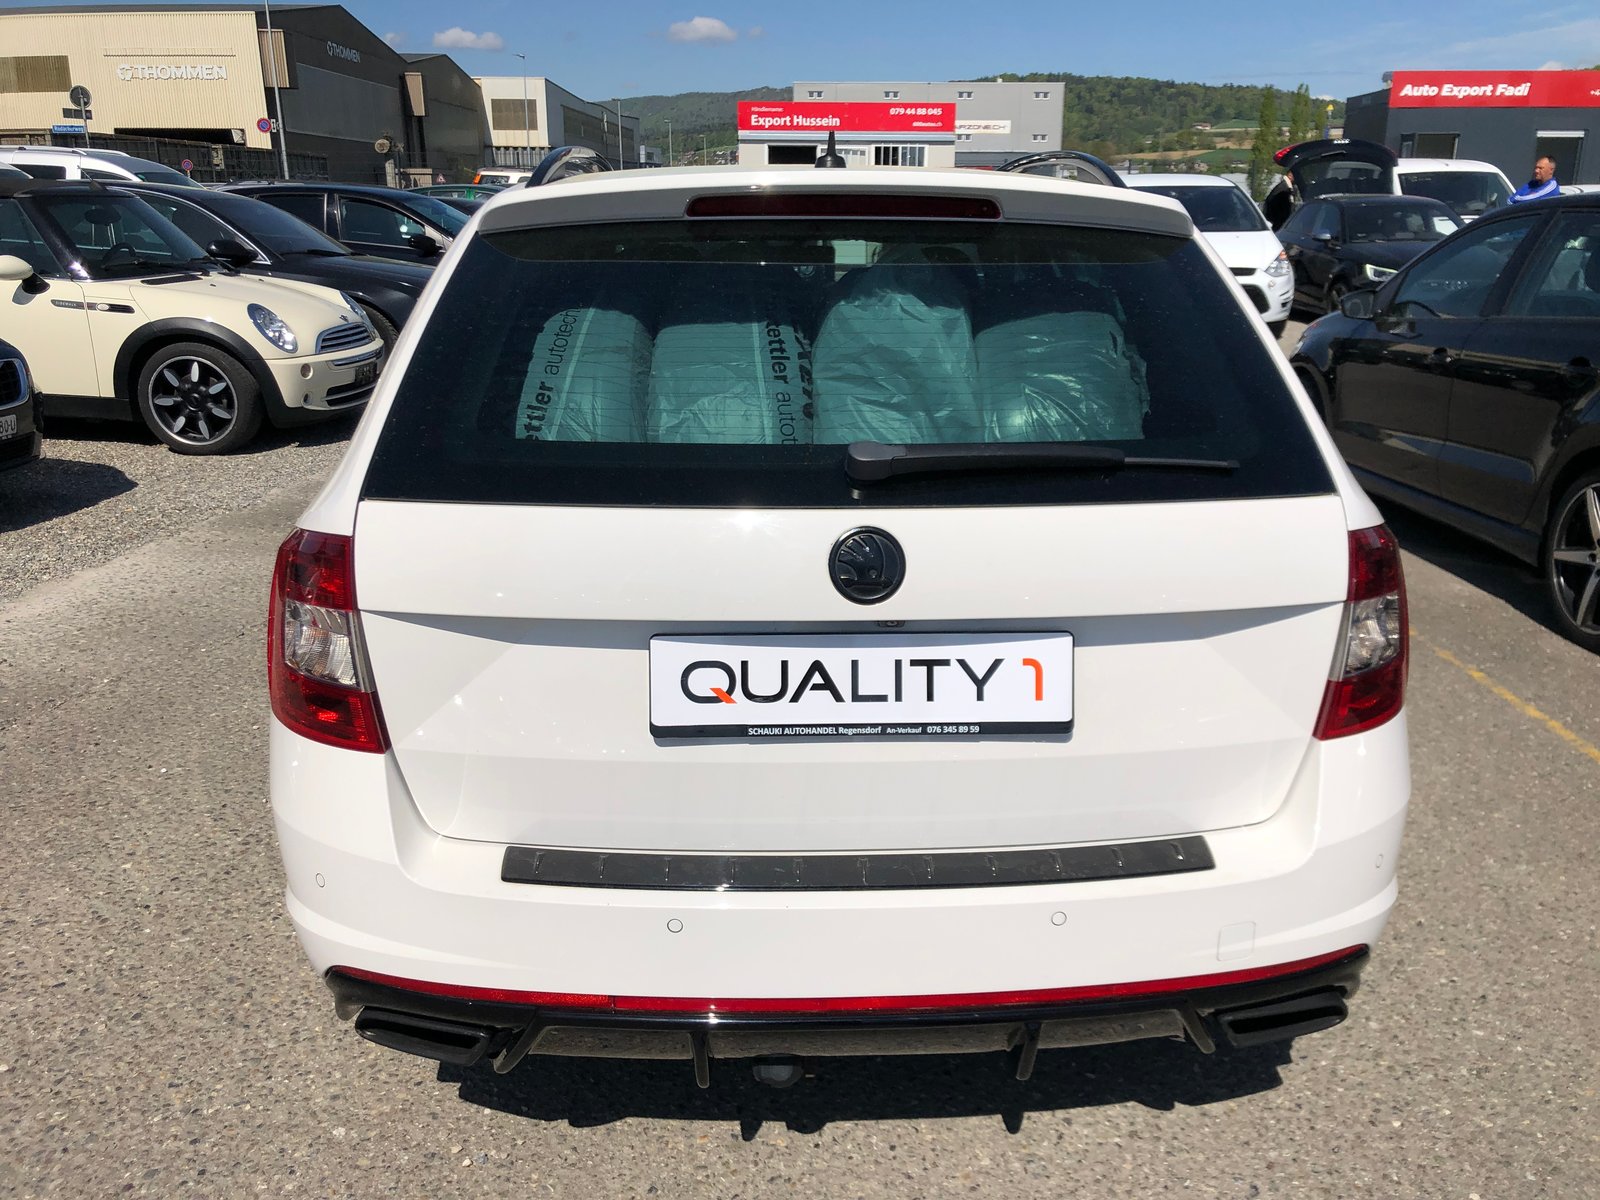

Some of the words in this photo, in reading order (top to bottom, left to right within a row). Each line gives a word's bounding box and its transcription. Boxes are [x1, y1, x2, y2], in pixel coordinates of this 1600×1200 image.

[331, 43, 361, 64] THOMMEN
[133, 64, 228, 80] THOMMEN
[1400, 84, 1439, 96] Auto
[1441, 84, 1493, 98] Export
[1495, 82, 1531, 96] Fadi
[889, 107, 905, 115] 079
[905, 107, 916, 115] 44
[916, 107, 927, 115] 88
[927, 107, 943, 115] 045
[751, 114, 791, 128] Export
[793, 114, 840, 126] Hussein
[544, 307, 581, 376] autotech
[680, 658, 1006, 704] QUALITY
[1022, 657, 1044, 702] 1
[748, 727, 783, 735] SCHAUKI
[783, 726, 837, 735] AUTOHANDEL
[838, 726, 882, 736] Regensdorf
[886, 726, 922, 734] An-Verkauf
[926, 725, 942, 733] 076
[942, 725, 957, 733] 345
[958, 725, 969, 733] 89
[969, 725, 980, 733] 59
